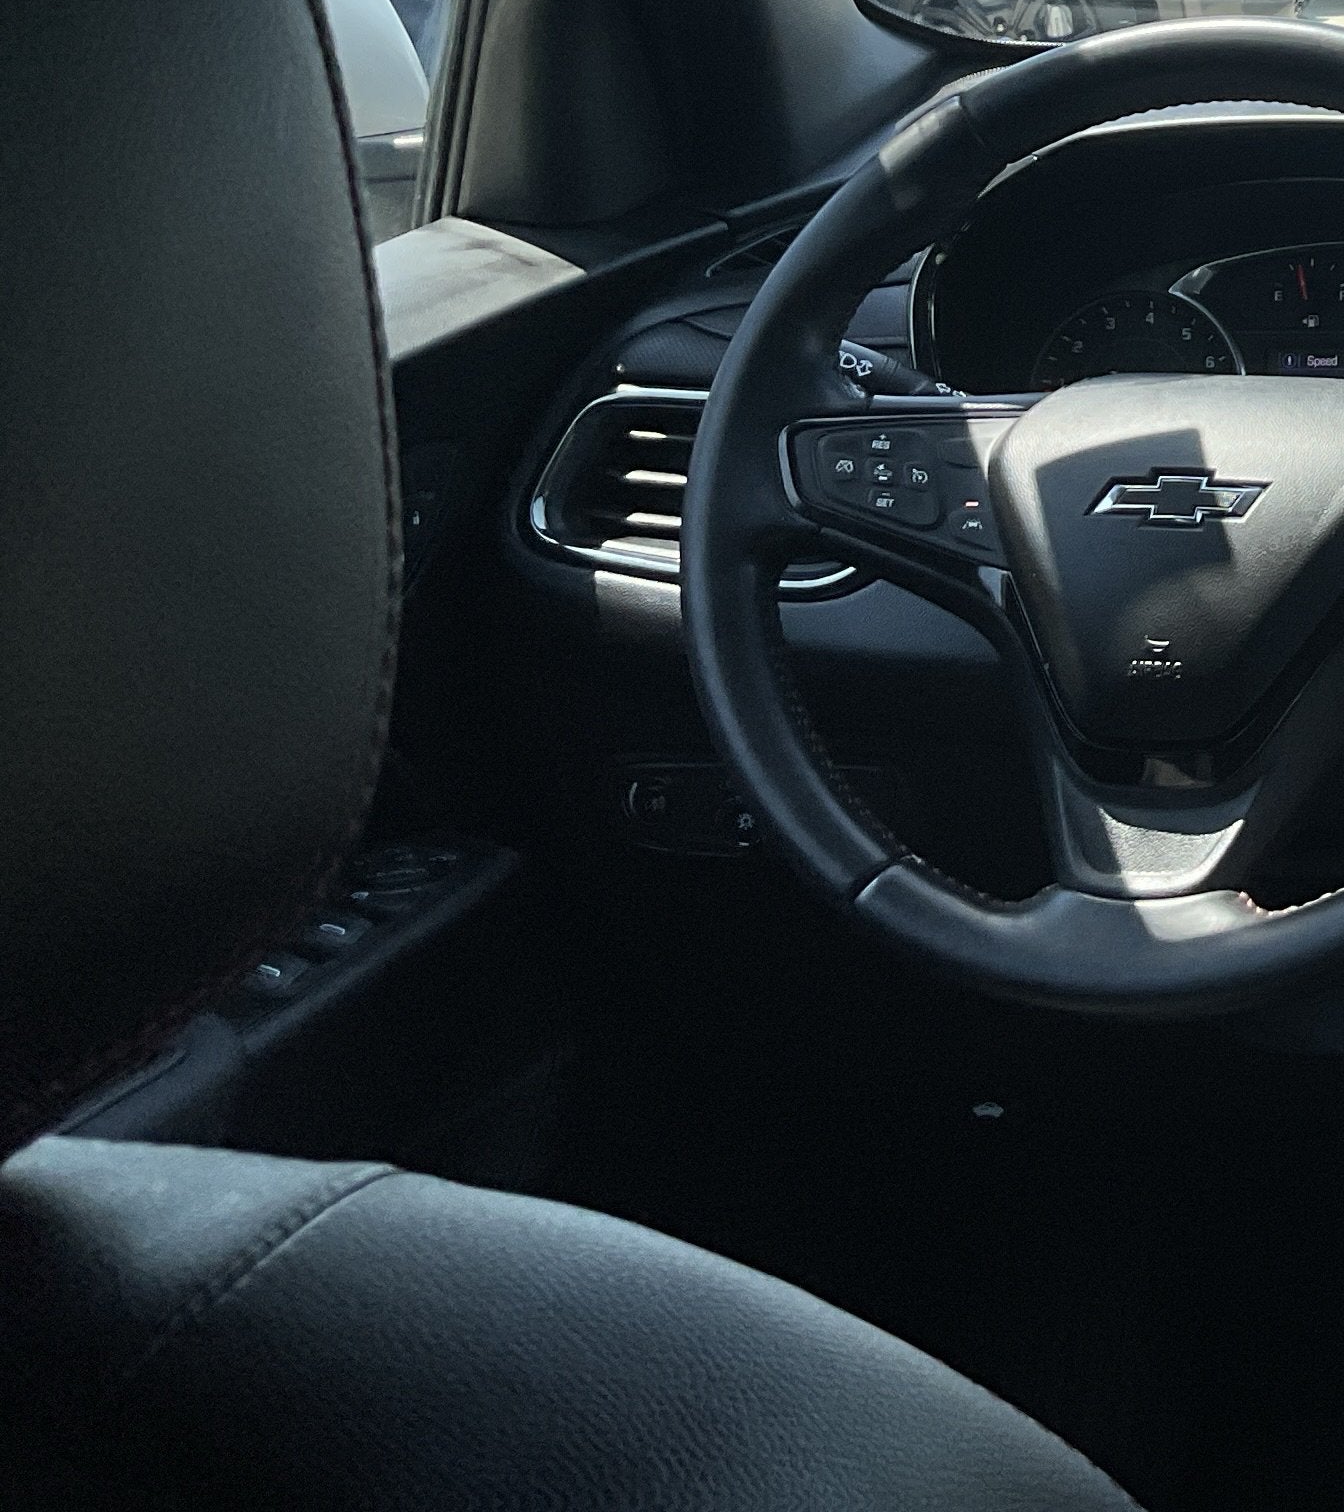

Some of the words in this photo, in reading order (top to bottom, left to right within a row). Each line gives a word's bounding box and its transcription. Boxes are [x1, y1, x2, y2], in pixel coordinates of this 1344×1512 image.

[1273, 289, 1284, 302] E
[1105, 317, 1117, 330] 3
[1145, 312, 1155, 325] 4
[1181, 327, 1192, 341] 5
[1071, 341, 1084, 354] 2
[1205, 355, 1216, 369] 6
[1306, 355, 1338, 369] Speed
[875, 496, 895, 508] SET
